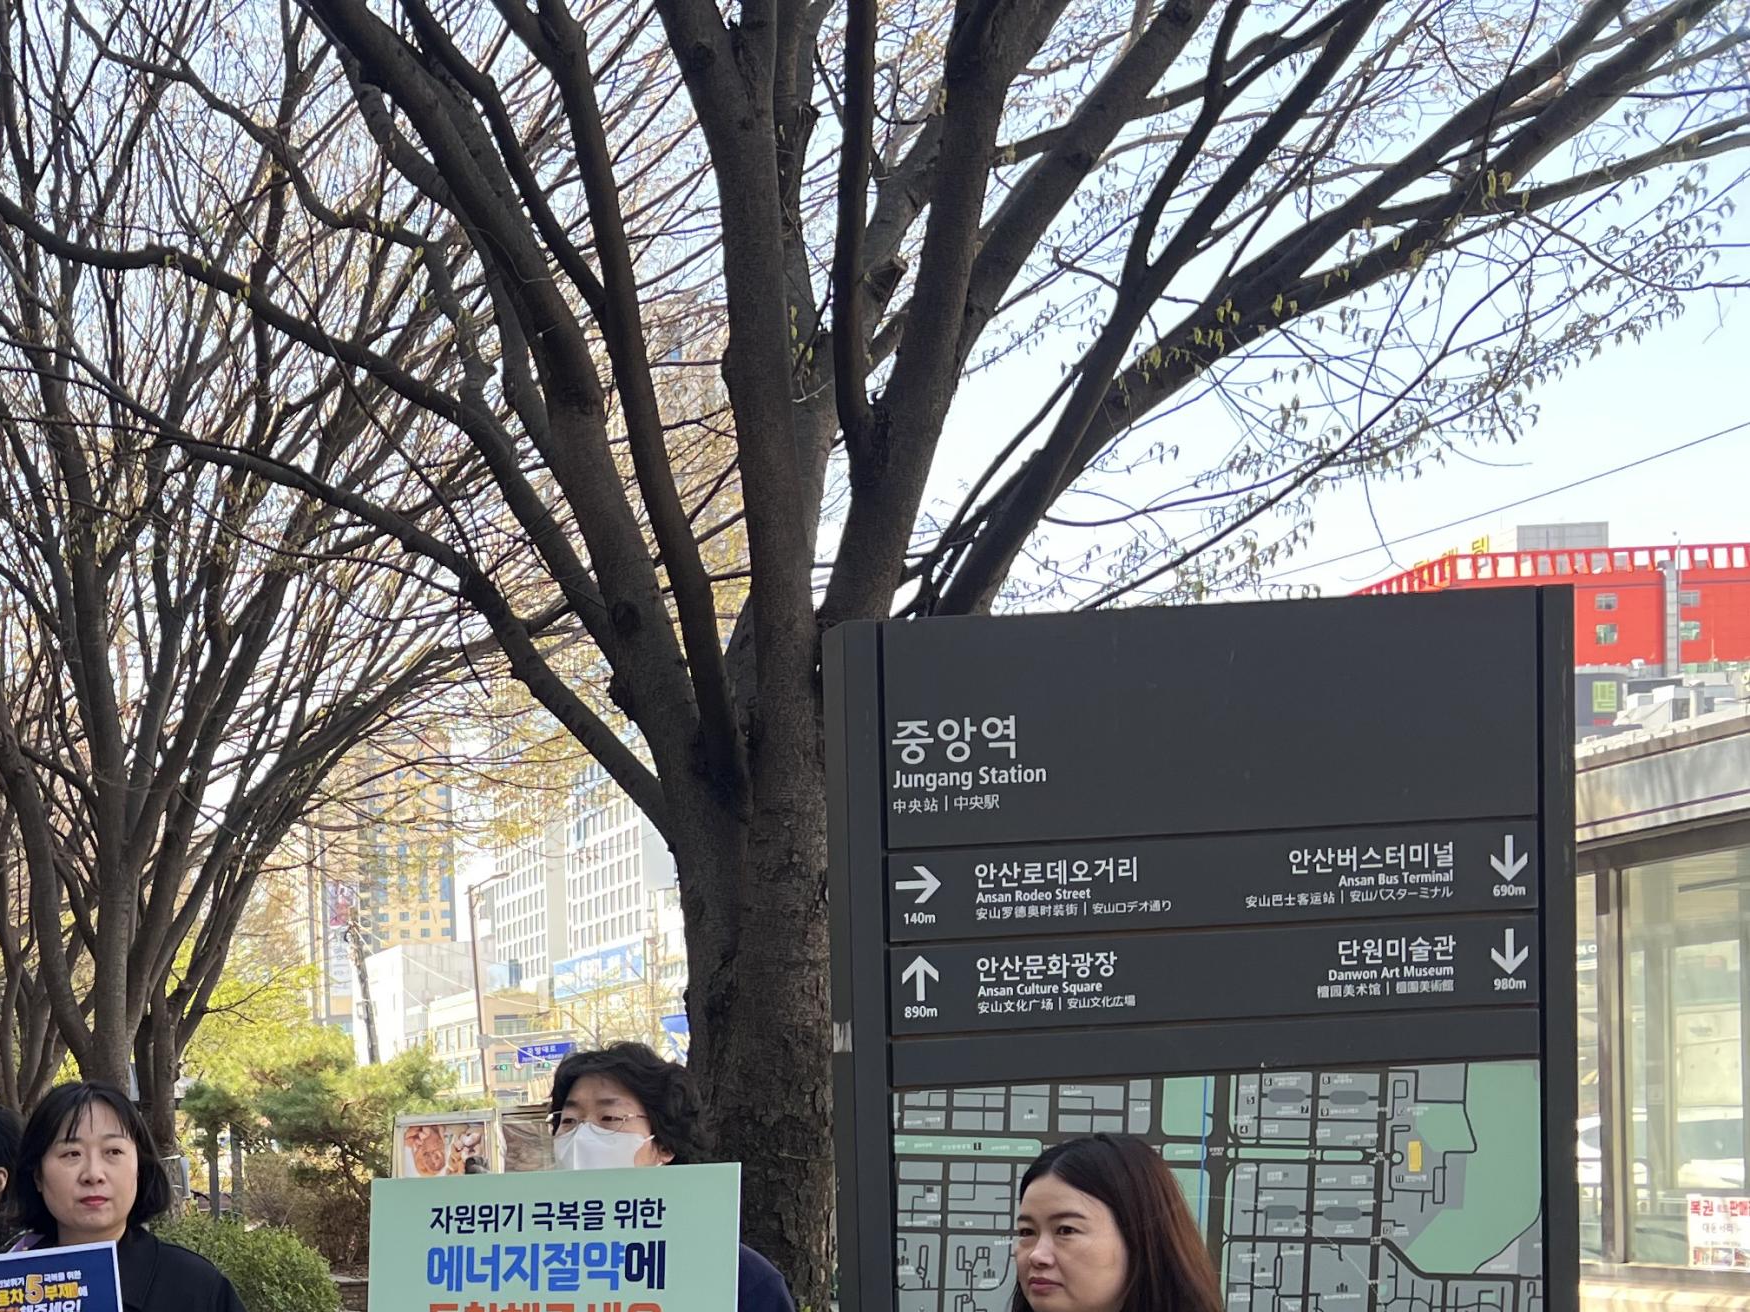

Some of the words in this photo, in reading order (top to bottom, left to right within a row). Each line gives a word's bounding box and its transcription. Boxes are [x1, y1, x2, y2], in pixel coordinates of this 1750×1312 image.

[892, 715, 1016, 765] 중앙역
[893, 769, 973, 791] Jungang
[979, 764, 1047, 785] Station
[893, 798, 938, 814] 中央站
[954, 794, 1000, 811] 中央駅
[1288, 841, 1453, 875] 안산버스터미널
[975, 856, 1138, 889] 안산로데오거리
[1338, 875, 1375, 888] Ansan
[1378, 872, 1399, 885] Bus
[1402, 869, 1453, 884] Terminal
[976, 891, 1012, 904] Ansan
[1015, 889, 1052, 902] Rodeo
[1055, 887, 1091, 900] Street
[1349, 886, 1453, 904] 安山バスターミナル
[1492, 884, 1526, 897] 690m
[903, 912, 936, 925] 140m
[1337, 935, 1457, 965] 단원미술관
[975, 951, 1118, 982] 안산문화광장
[1328, 968, 1377, 982] Danwon
[1380, 966, 1400, 979] Art
[1403, 965, 1454, 978] Museum
[977, 985, 1013, 998] Ansan
[1017, 982, 1059, 996] Culture
[1062, 981, 1103, 995] Square
[1493, 978, 1527, 991] 980m
[904, 1006, 938, 1019] 890m
[977, 999, 1054, 1015] 安山文化广场
[430, 1203, 524, 1234] 자원위기
[531, 1200, 606, 1231] 극복을
[613, 1198, 666, 1229] 위한
[426, 1240, 666, 1292] 에너지절약에
